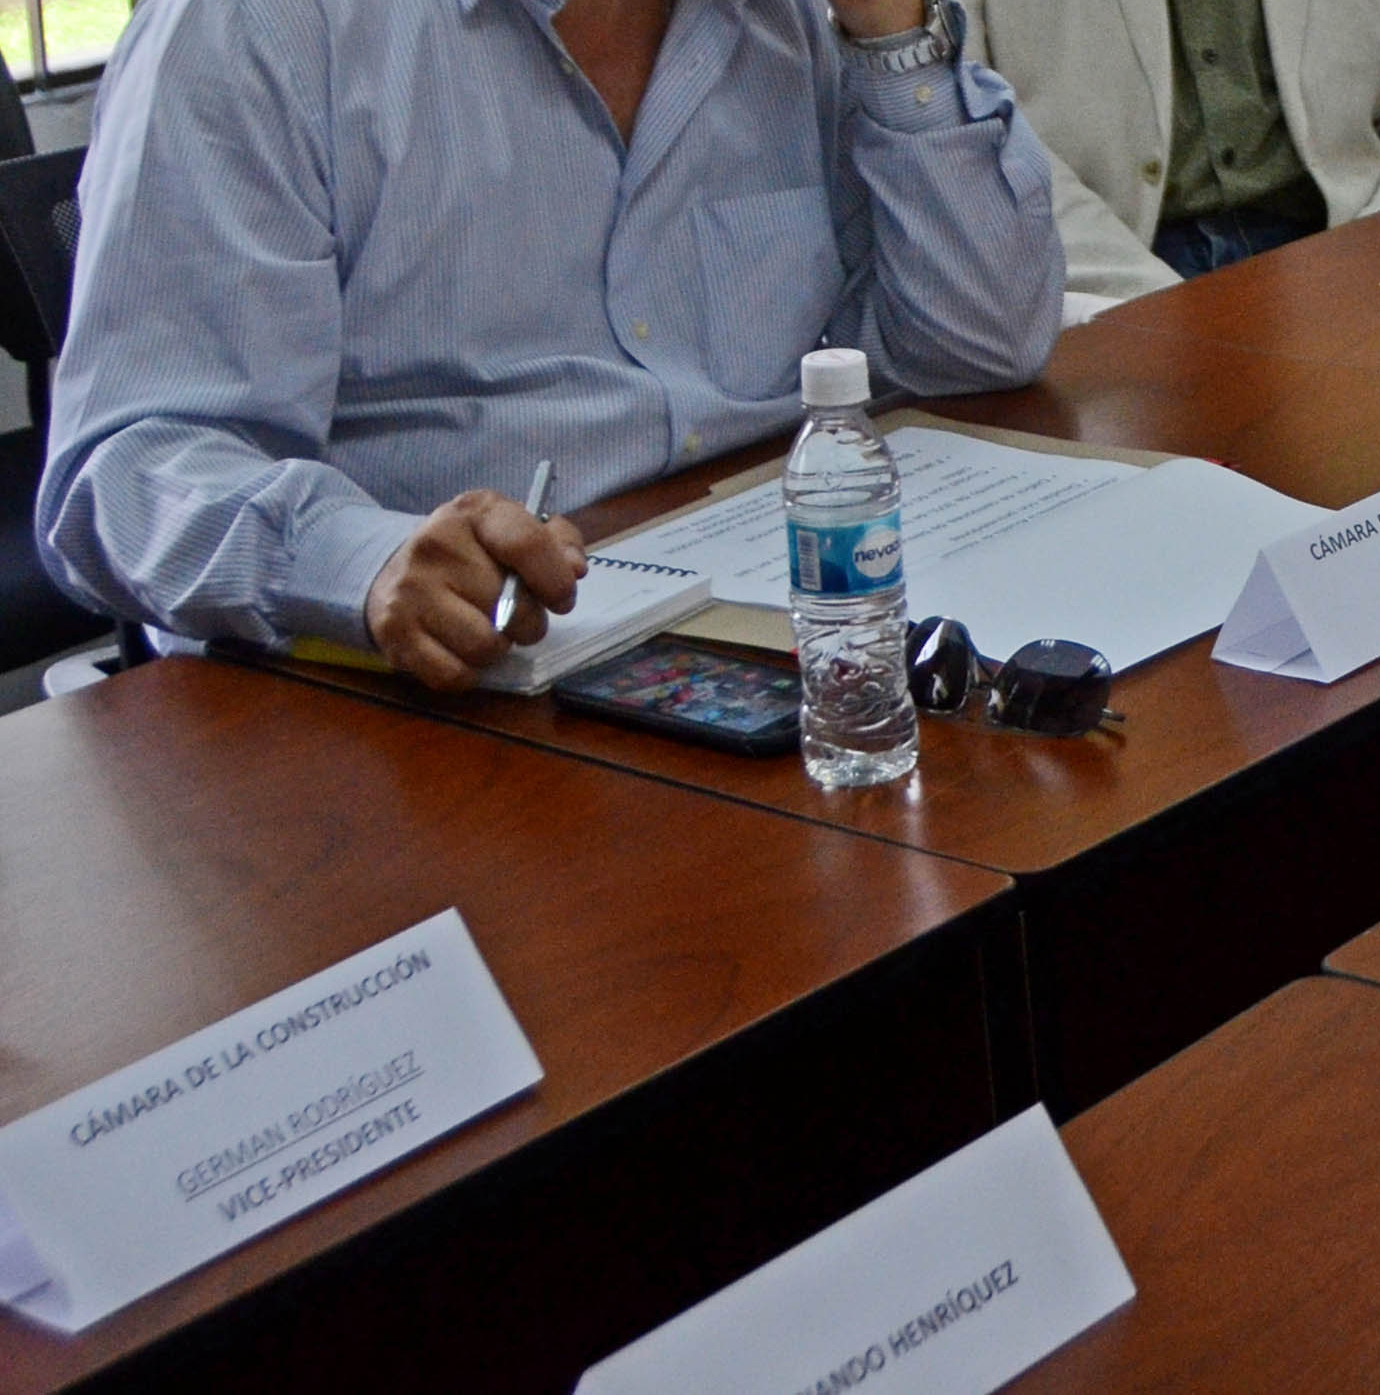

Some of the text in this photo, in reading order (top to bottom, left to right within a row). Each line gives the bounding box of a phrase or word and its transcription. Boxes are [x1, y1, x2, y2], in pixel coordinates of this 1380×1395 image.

[1310, 520, 1378, 560] CÁMARA
[73, 950, 431, 1147] CÁMARA DE LA CONSTRUCCIÓN
[288, 1049, 426, 1136] RODRÍGUEZ
[218, 1098, 421, 1222] VICE-PRESIDENTE
[796, 1260, 1019, 1395] ANDO HENRÍQUEZ
